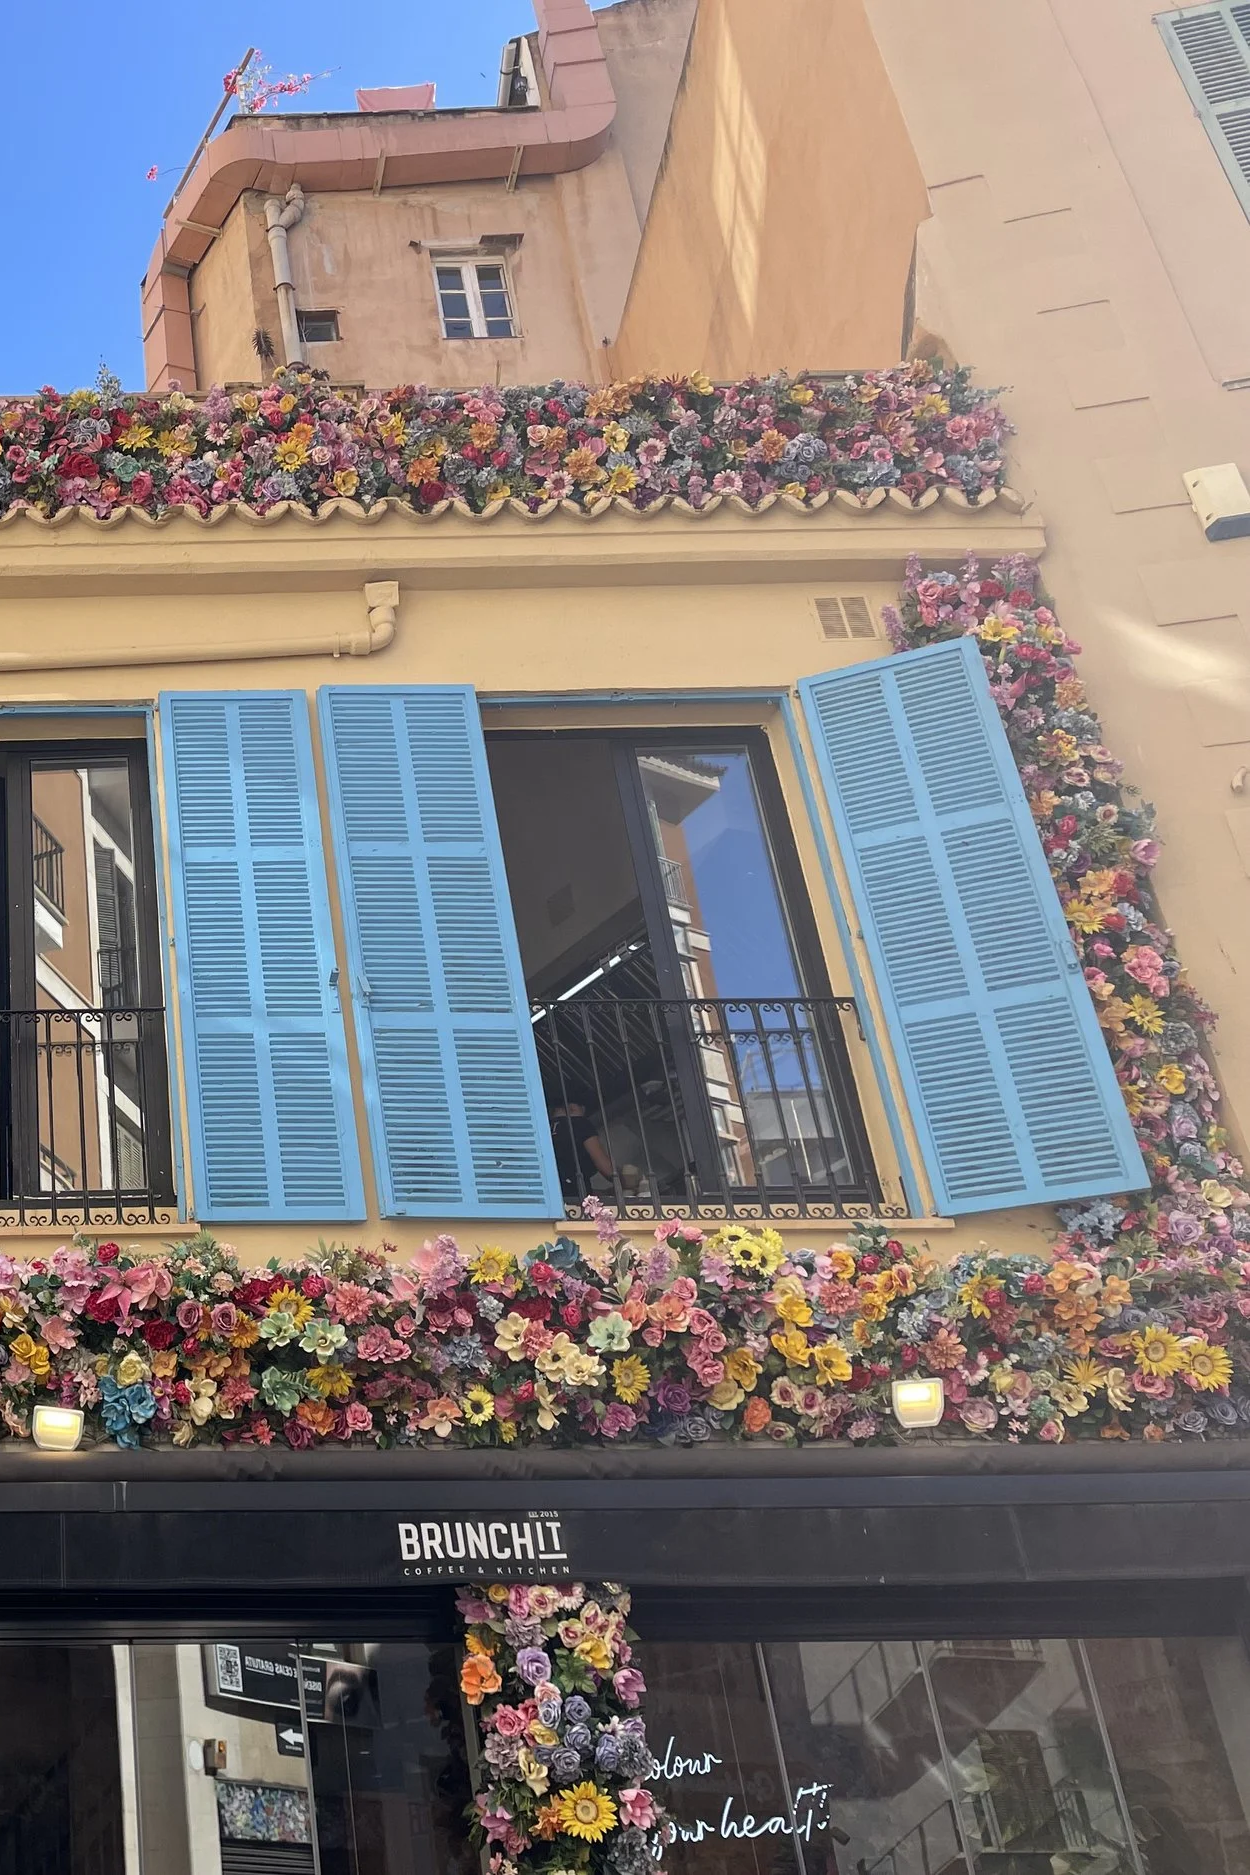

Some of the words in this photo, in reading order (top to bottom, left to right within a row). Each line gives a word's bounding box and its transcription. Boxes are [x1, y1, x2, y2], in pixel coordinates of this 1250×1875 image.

[539, 1510, 559, 1518] 2015
[398, 1521, 568, 1561] BRUNCHIT
[404, 1565, 465, 1576] COFFEE
[477, 1566, 485, 1574] &
[497, 1565, 570, 1575] KITCHEN
[646, 1736, 723, 1781] olour
